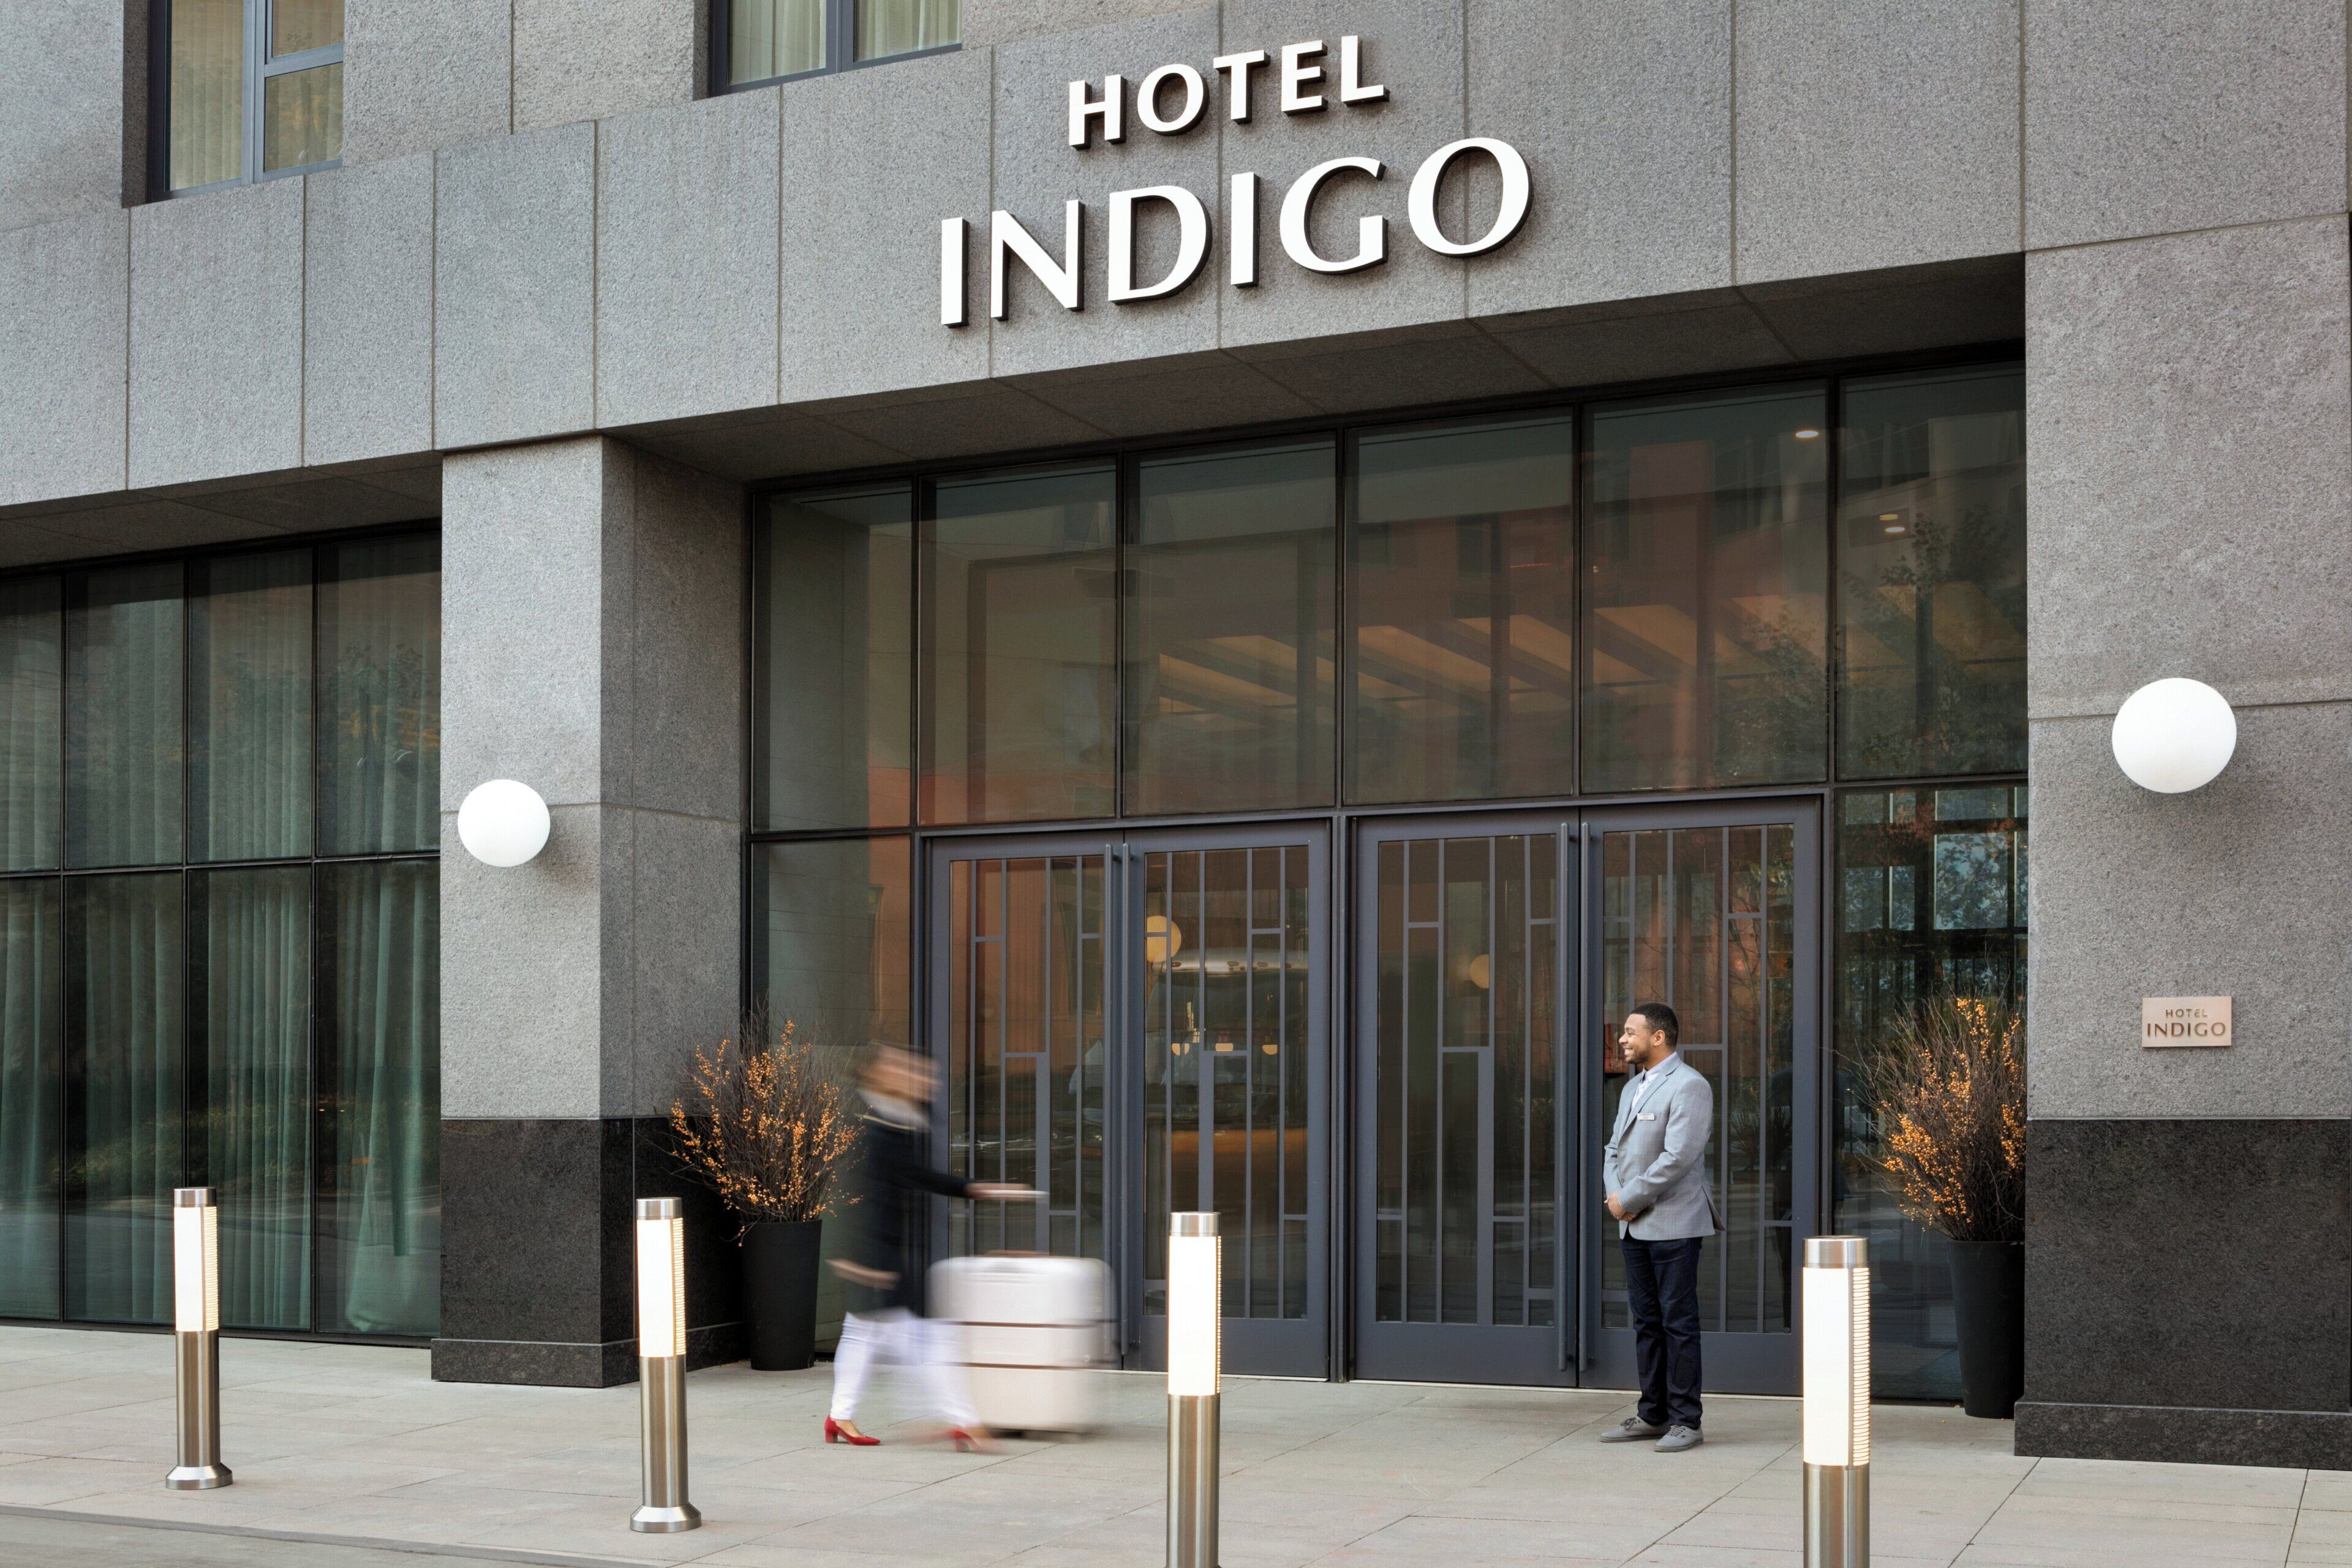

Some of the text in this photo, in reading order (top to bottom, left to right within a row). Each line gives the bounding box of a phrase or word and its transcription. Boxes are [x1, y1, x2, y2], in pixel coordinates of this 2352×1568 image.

[1069, 35, 1389, 150] HOTEL
[941, 137, 1534, 328] INDIGO
[2147, 1022, 2226, 1037] INDIGO
[2165, 1009, 2208, 1018] HOTEL
